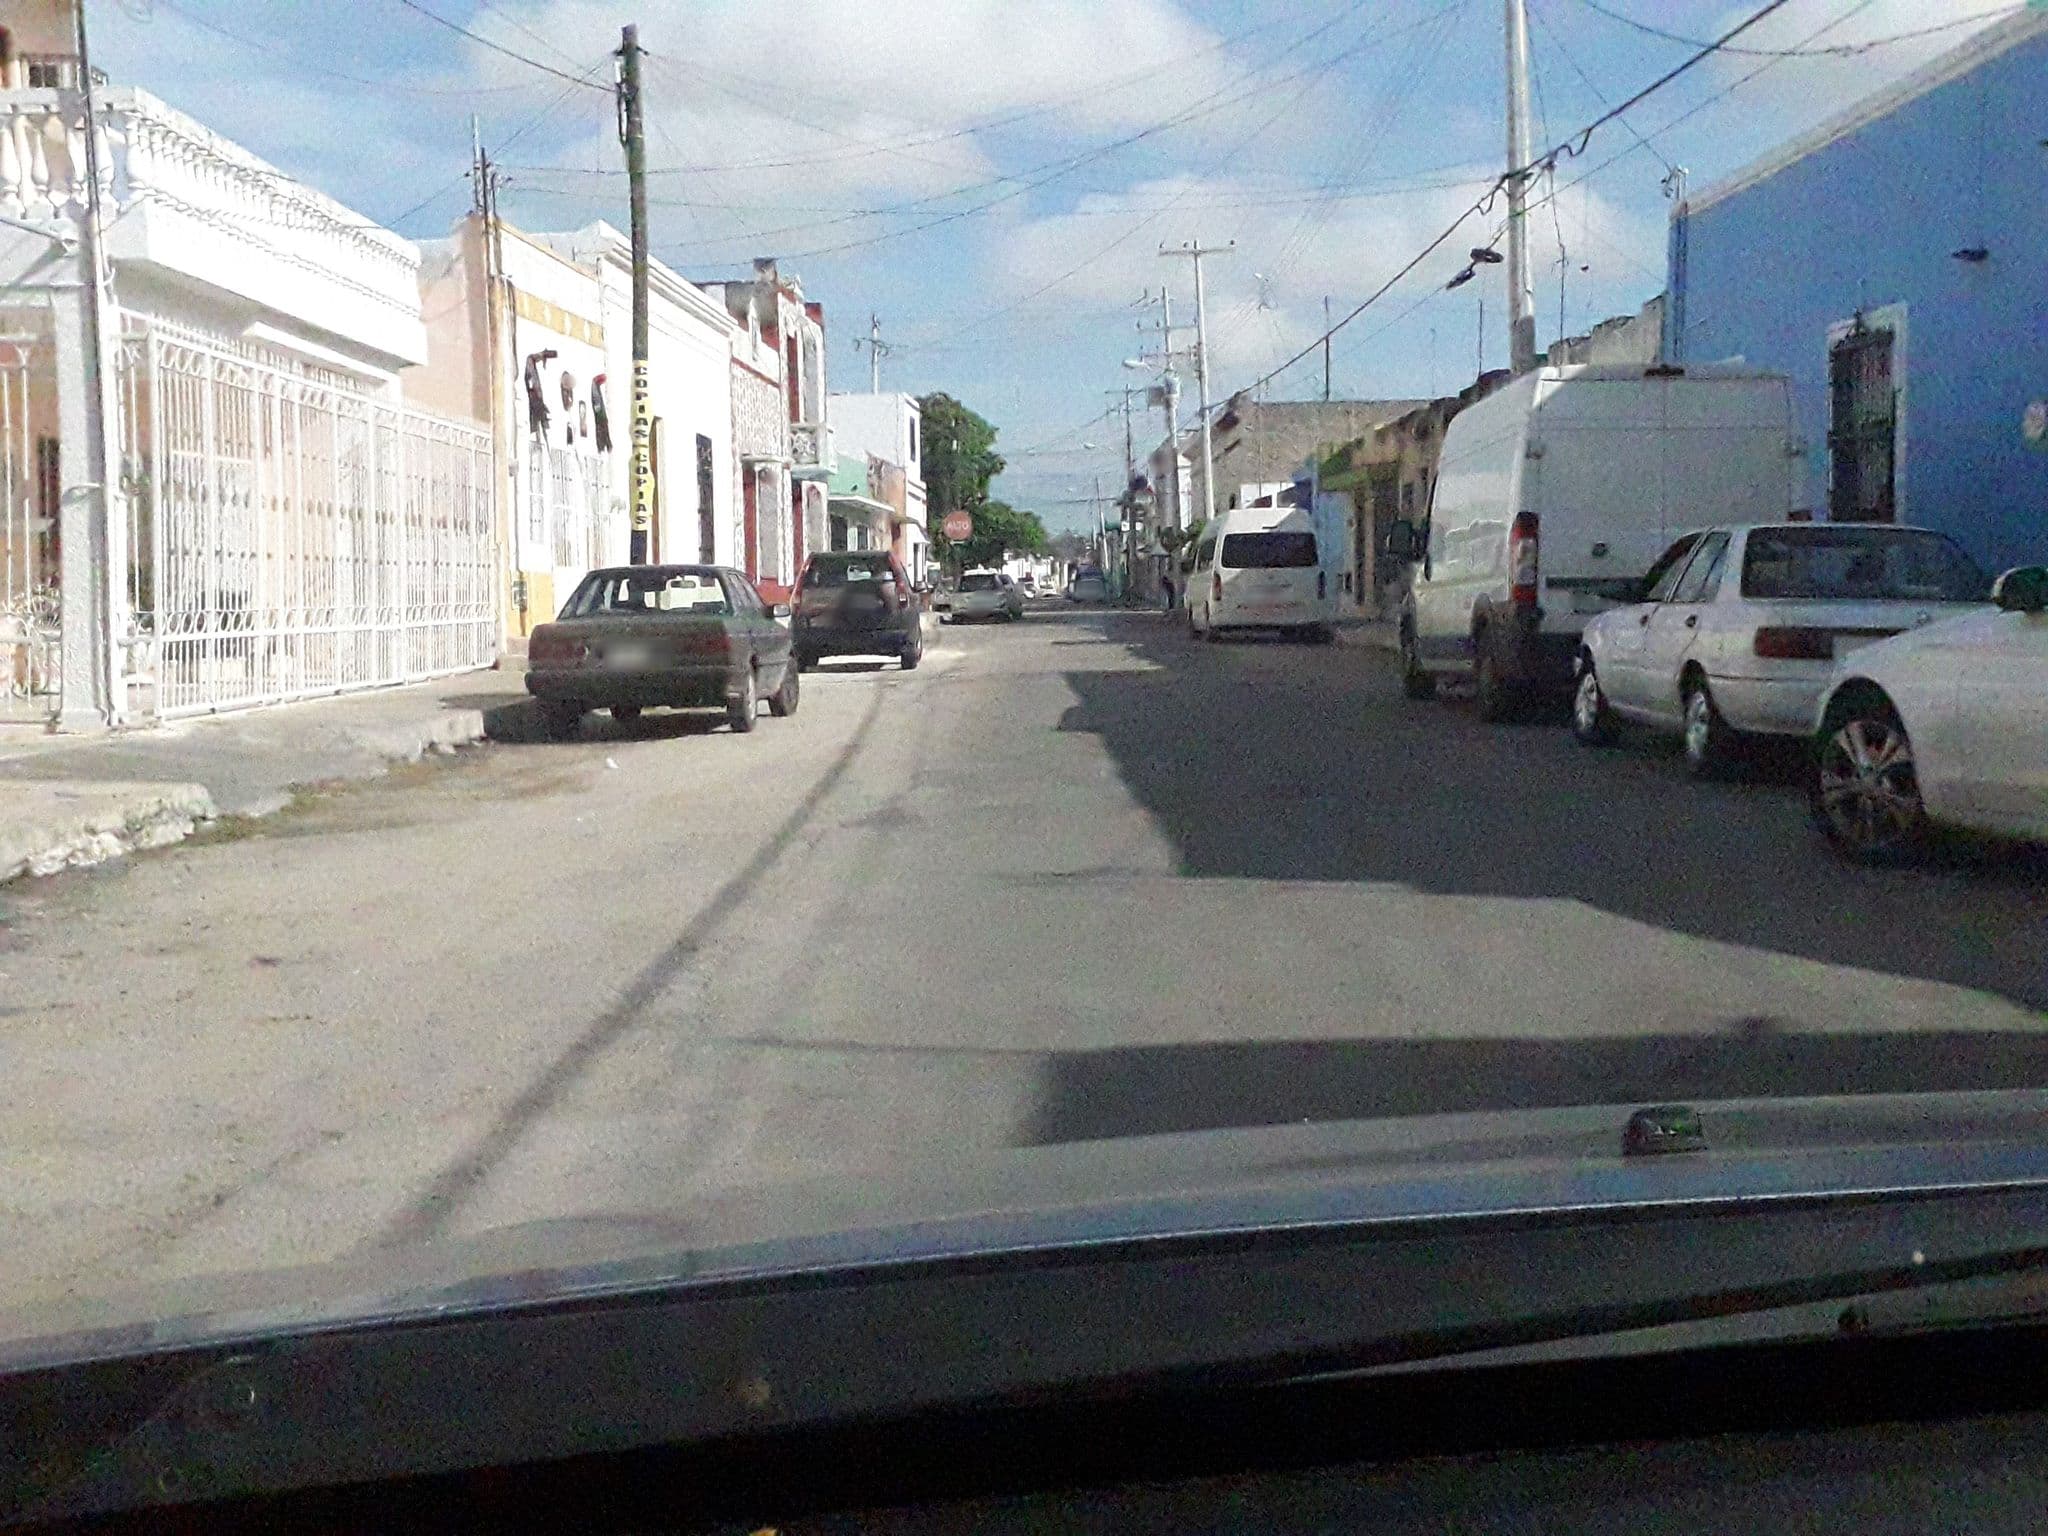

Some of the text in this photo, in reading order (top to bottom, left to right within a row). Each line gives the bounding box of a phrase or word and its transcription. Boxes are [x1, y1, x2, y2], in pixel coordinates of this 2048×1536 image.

[634, 366, 648, 524] COPIAS COPIAS
[946, 519, 970, 531] ALTO
